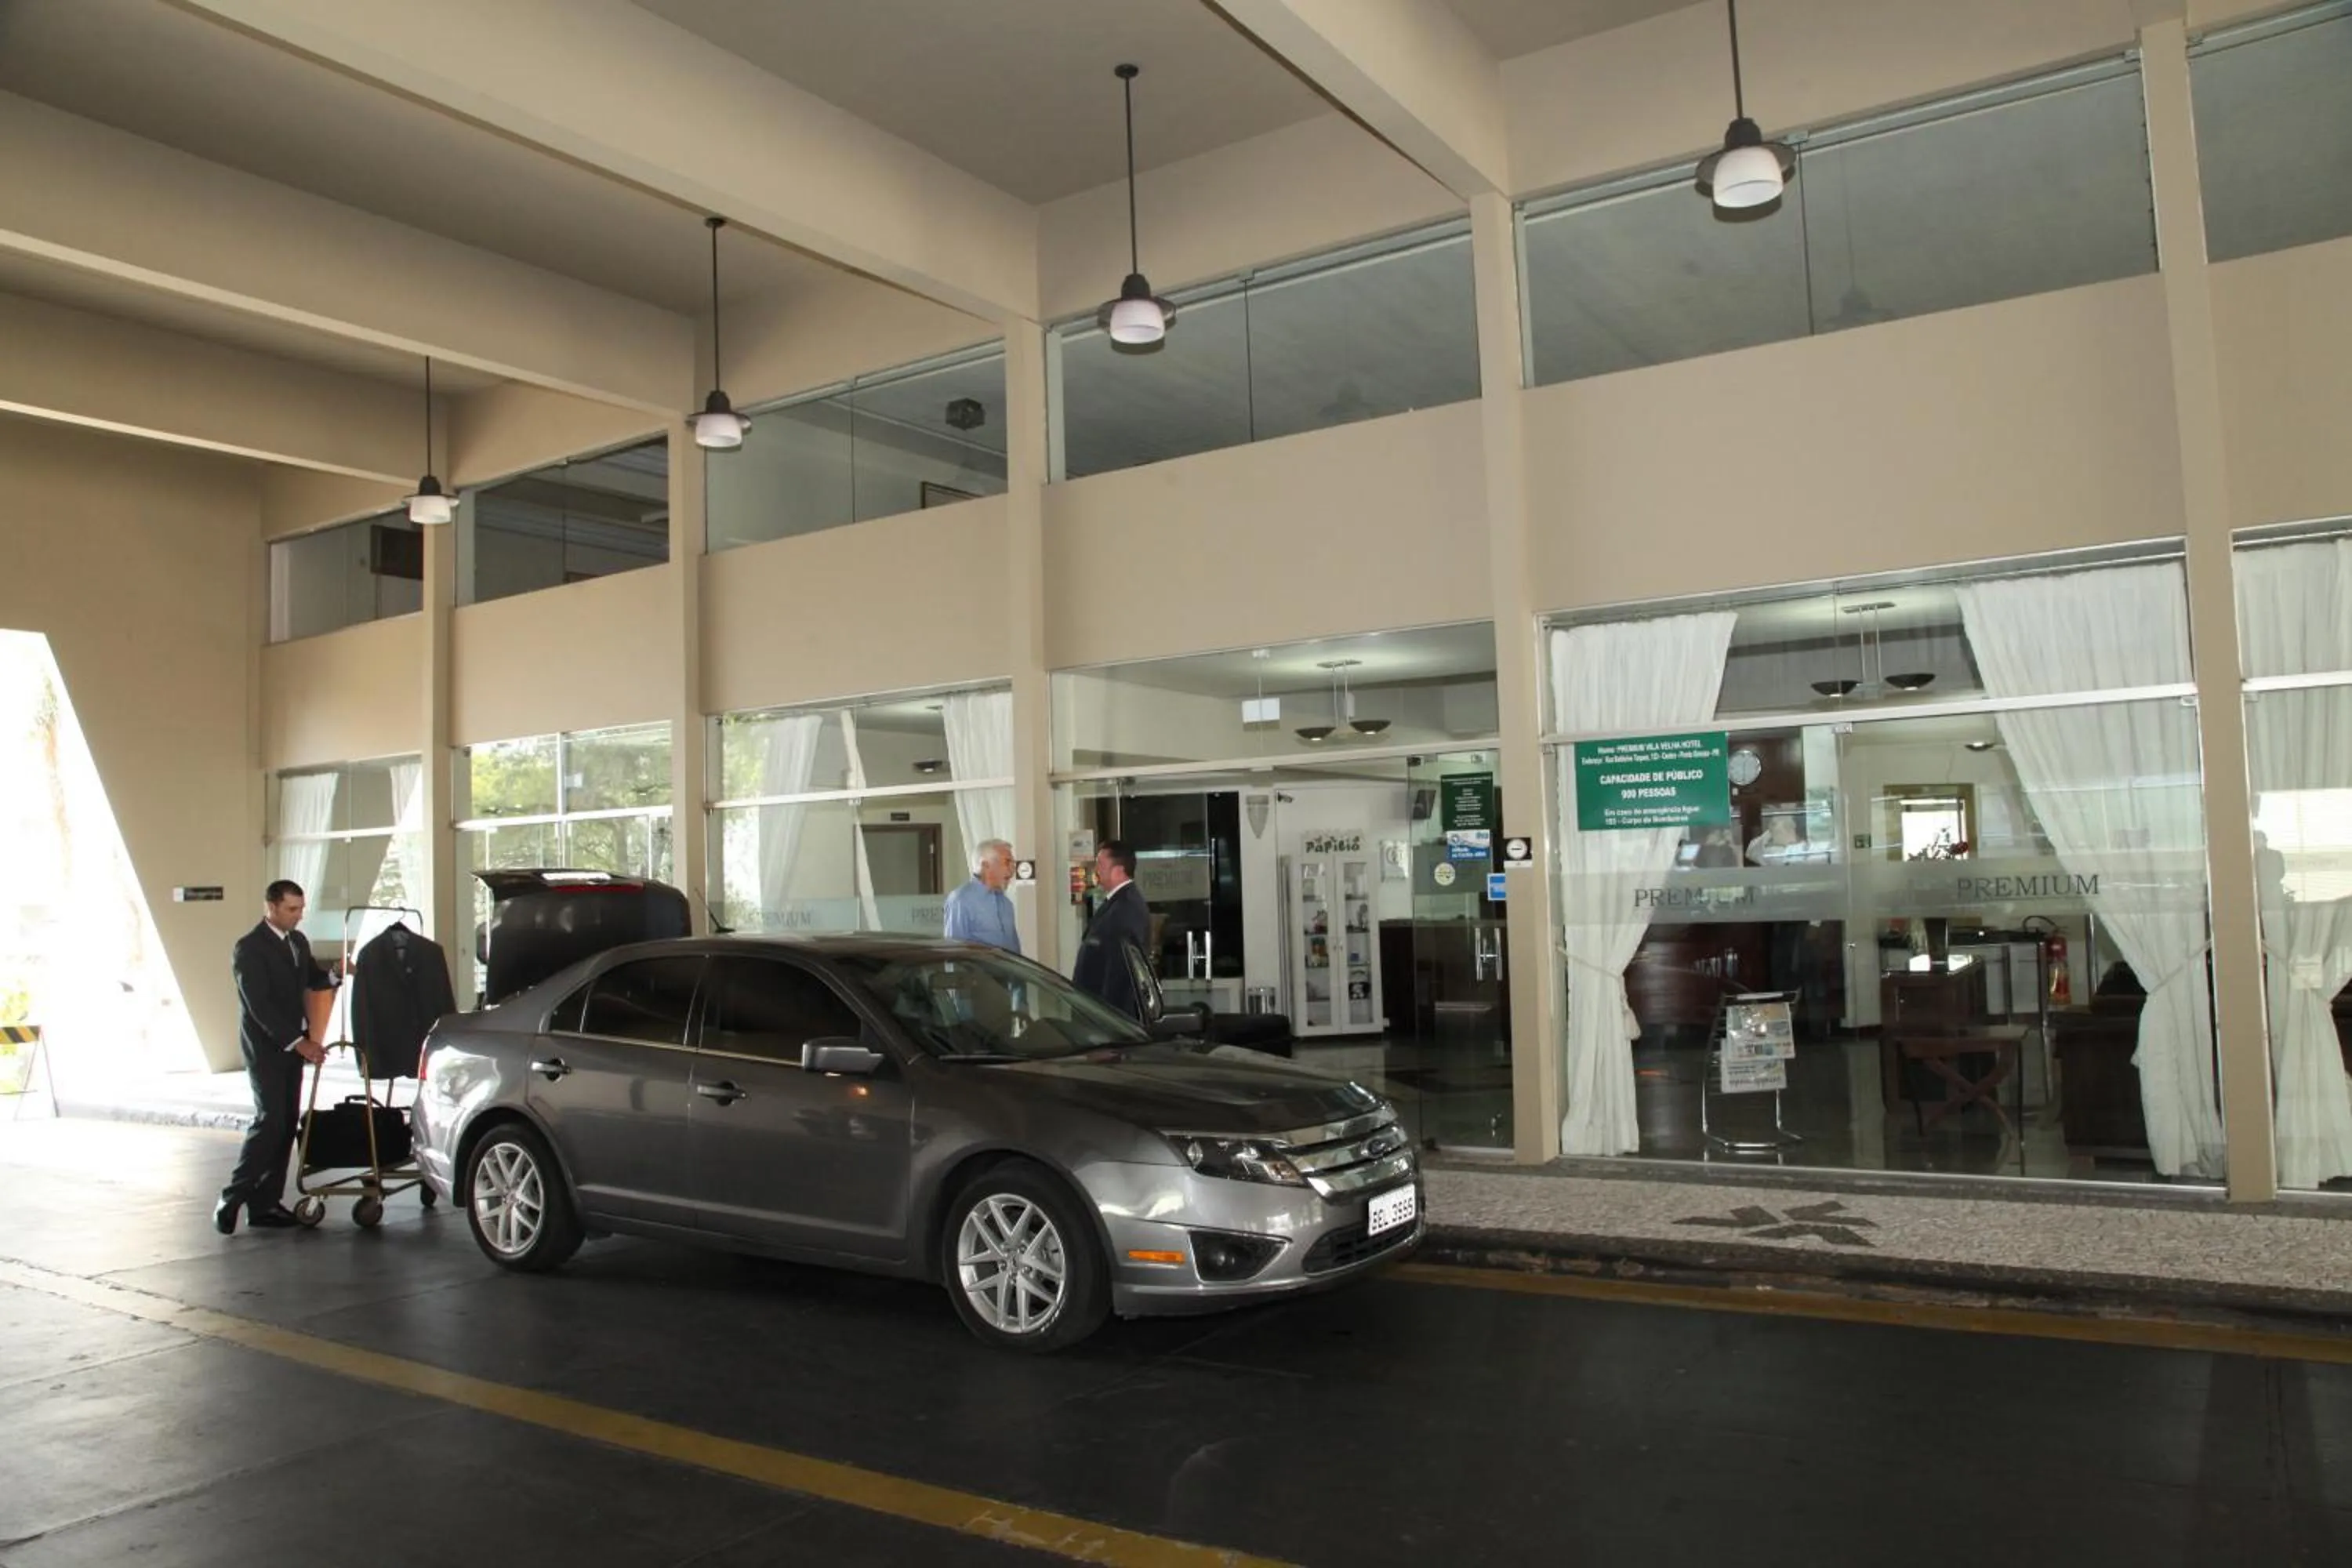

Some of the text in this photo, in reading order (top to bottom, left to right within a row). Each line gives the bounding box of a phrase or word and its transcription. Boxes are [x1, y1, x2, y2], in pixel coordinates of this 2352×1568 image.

[1600, 768, 1703, 784] CAPACIDADE DE PÚBLICO
[1638, 786, 1676, 798] PESSOAS
[1957, 873, 2100, 898] PREMIUM
